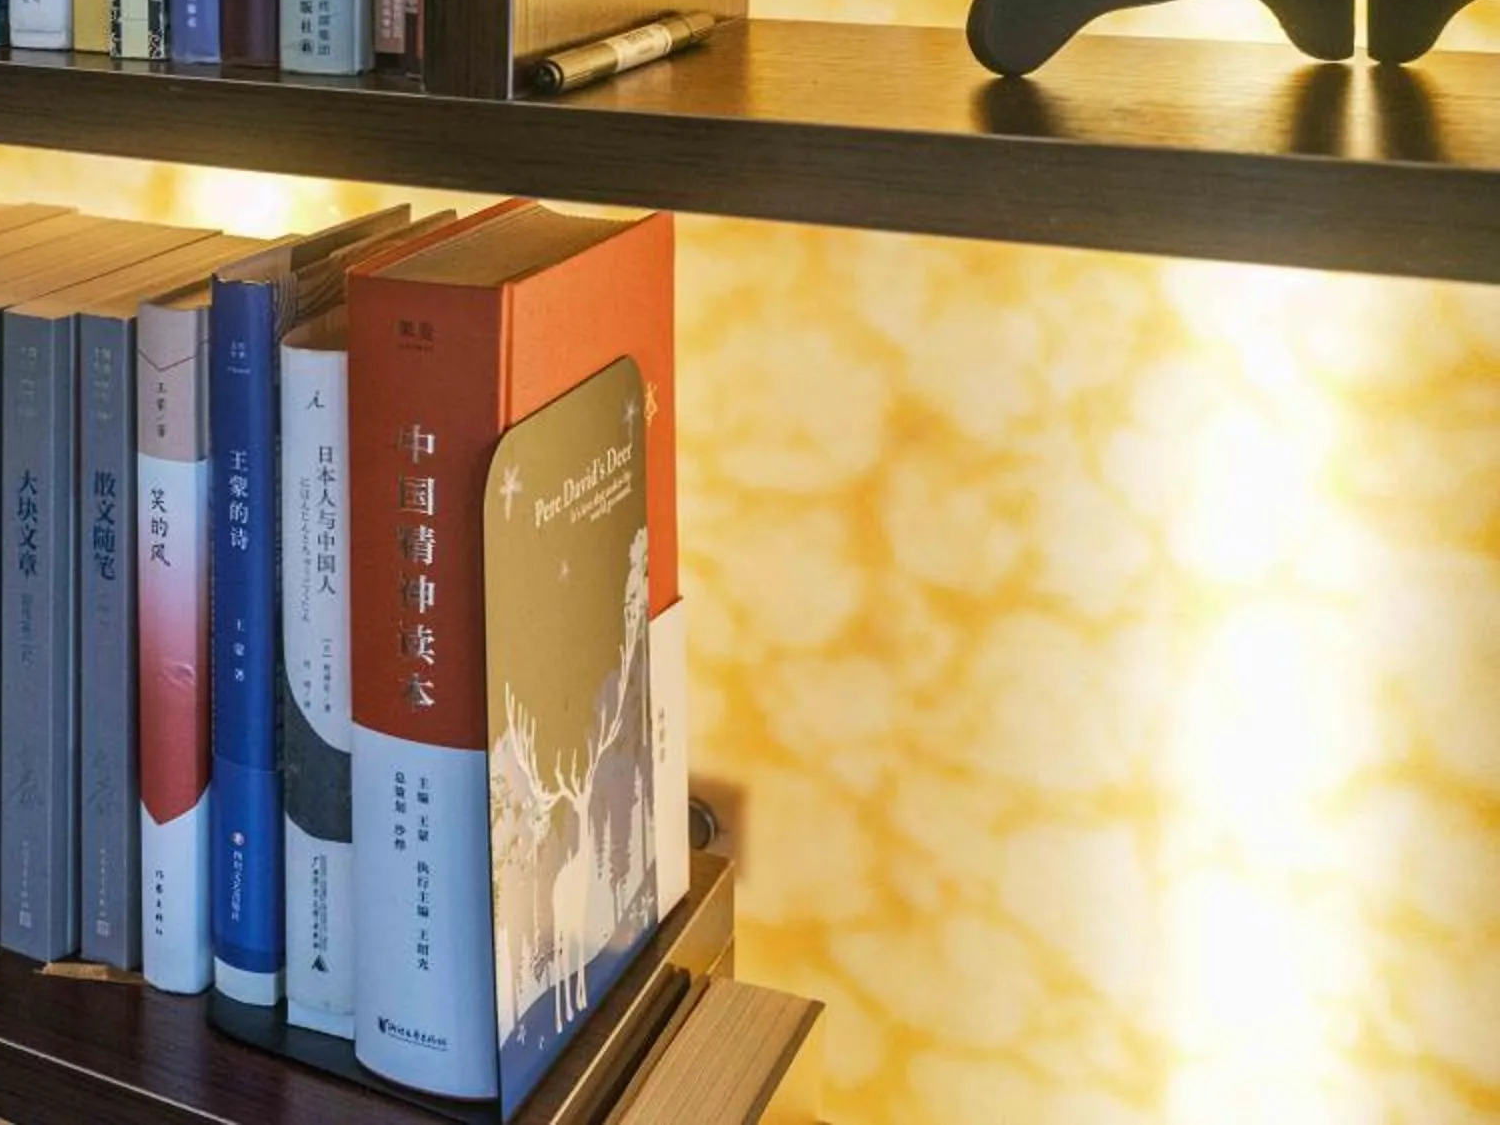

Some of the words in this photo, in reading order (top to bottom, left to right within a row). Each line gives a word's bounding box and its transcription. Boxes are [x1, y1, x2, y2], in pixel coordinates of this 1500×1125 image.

[16, 469, 39, 580] 大块文章
[92, 469, 117, 582] 散文随笔
[150, 488, 171, 568] 笑的风
[228, 449, 250, 552] 王蒙的诗
[316, 445, 337, 597] 日本人与中国人
